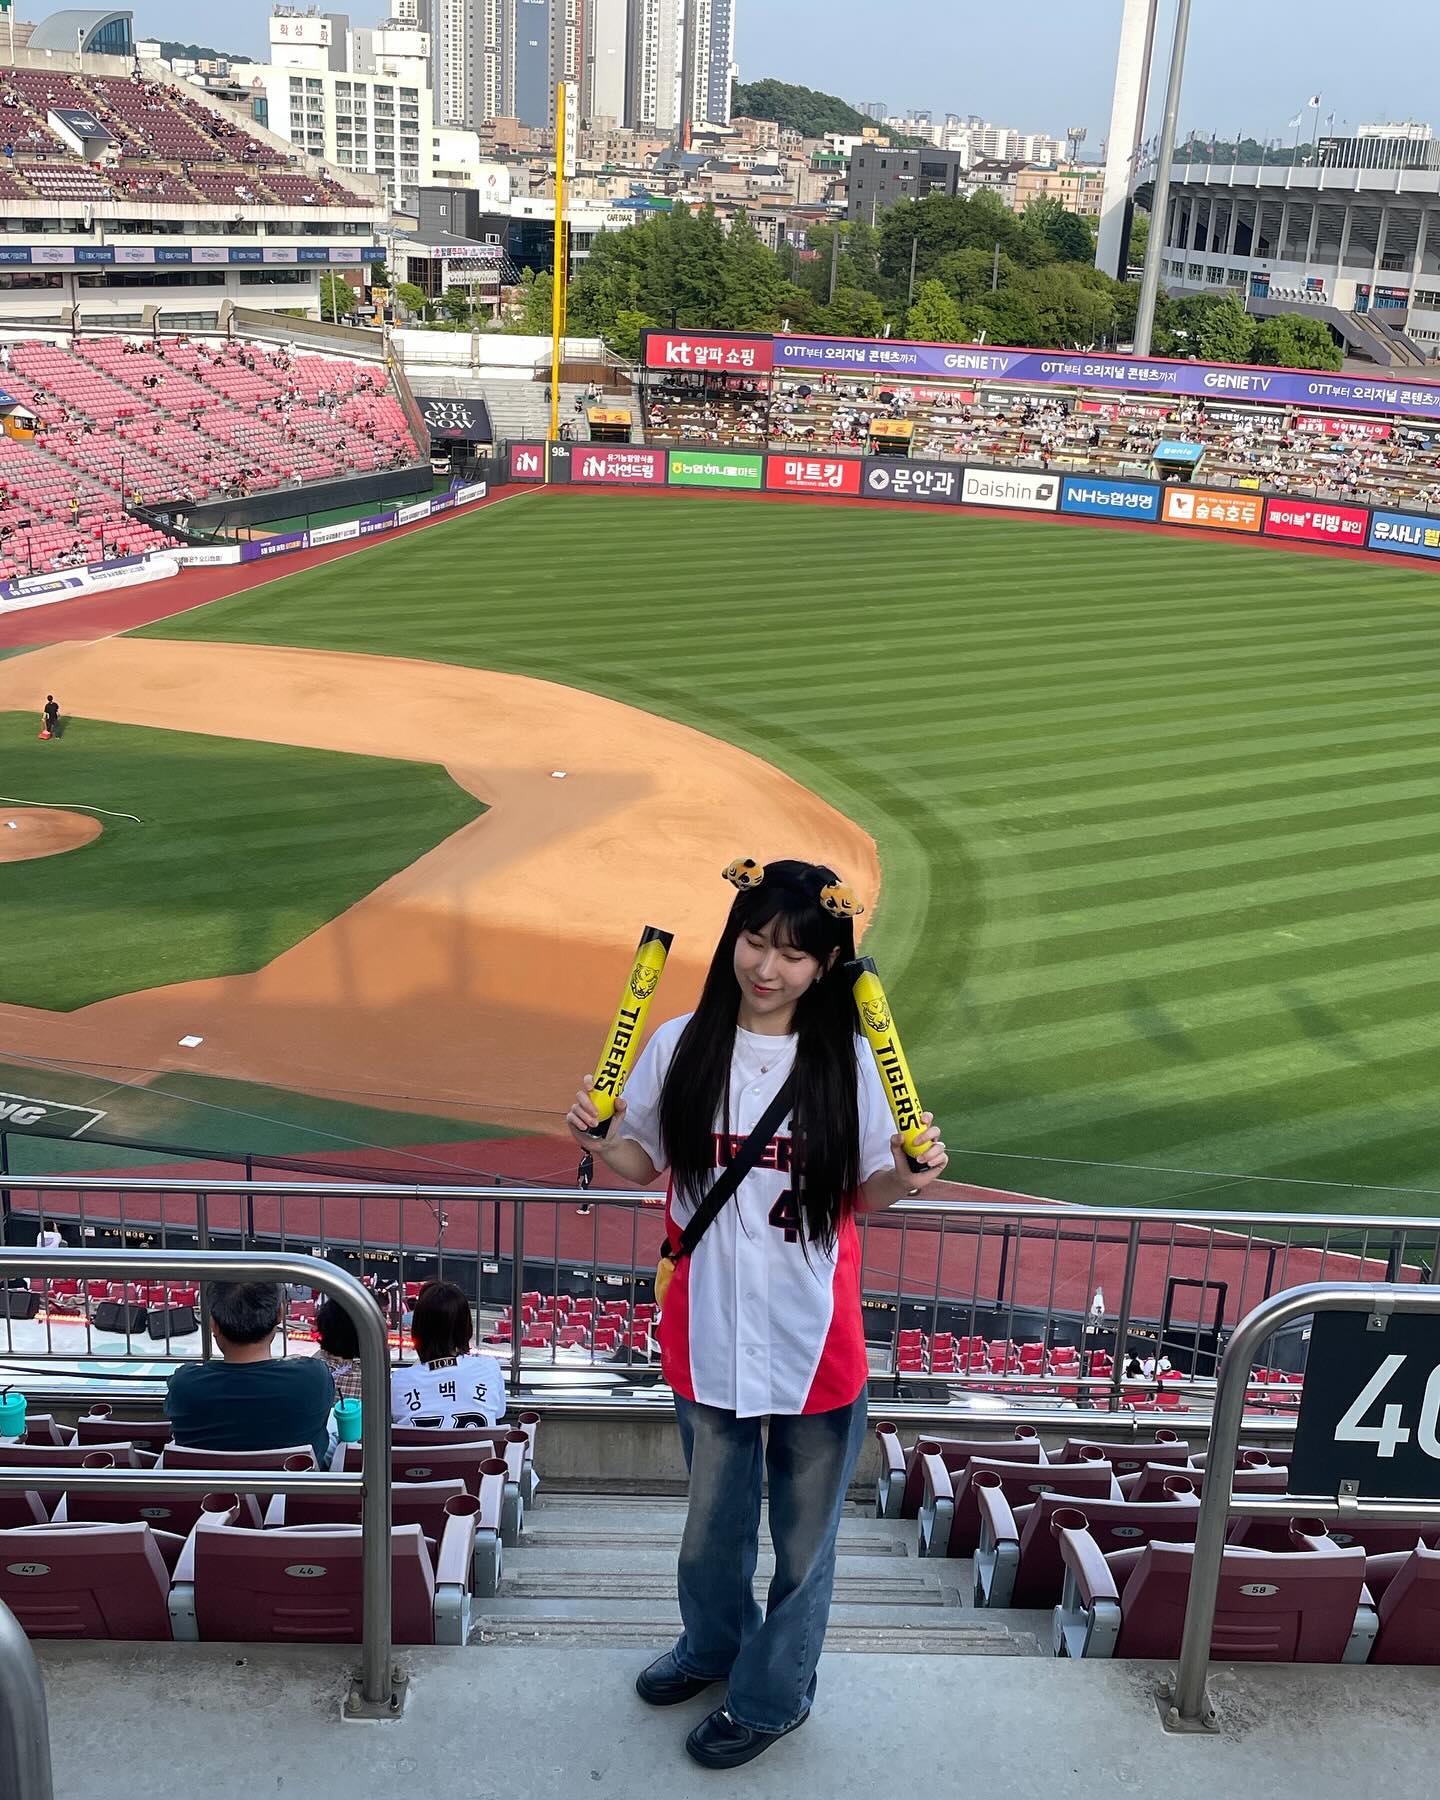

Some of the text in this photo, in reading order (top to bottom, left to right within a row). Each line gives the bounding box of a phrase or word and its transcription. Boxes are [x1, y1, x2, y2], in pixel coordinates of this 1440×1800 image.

[666, 341, 755, 367] kt 알파 쇼핑
[783, 345, 917, 364] OTT부터 오리지널 콘텐츠까지
[944, 353, 1009, 371] GENIE TV
[1041, 361, 1177, 383] OTT부터 오리지널 콘텐츠까지
[1203, 373, 1271, 391] GENIE TV
[1308, 382, 1350, 398] OTT부터
[1352, 386, 1398, 403] 오리지널
[424, 410, 472, 421] GOT
[428, 401, 466, 412] WE
[424, 418, 476, 429] NOW
[551, 446, 570, 457] 98m
[606, 463, 654, 479] 자연드림
[785, 462, 843, 488] 마트킹
[891, 468, 955, 496] 문안과
[967, 478, 1031, 500] Daishin
[1067, 487, 1153, 510] NH농협생명
[1195, 502, 1256, 525] 숲속호두
[1312, 513, 1340, 533] 티빙
[1341, 519, 1363, 534] 할인
[1374, 522, 1422, 545] 유사나
[593, 1006, 641, 1097] TIGERS
[876, 1037, 920, 1132] TIGERS
[21, 1565, 36, 1574] 47
[299, 1567, 314, 1575] 46
[1251, 1586, 1267, 1594] 58
